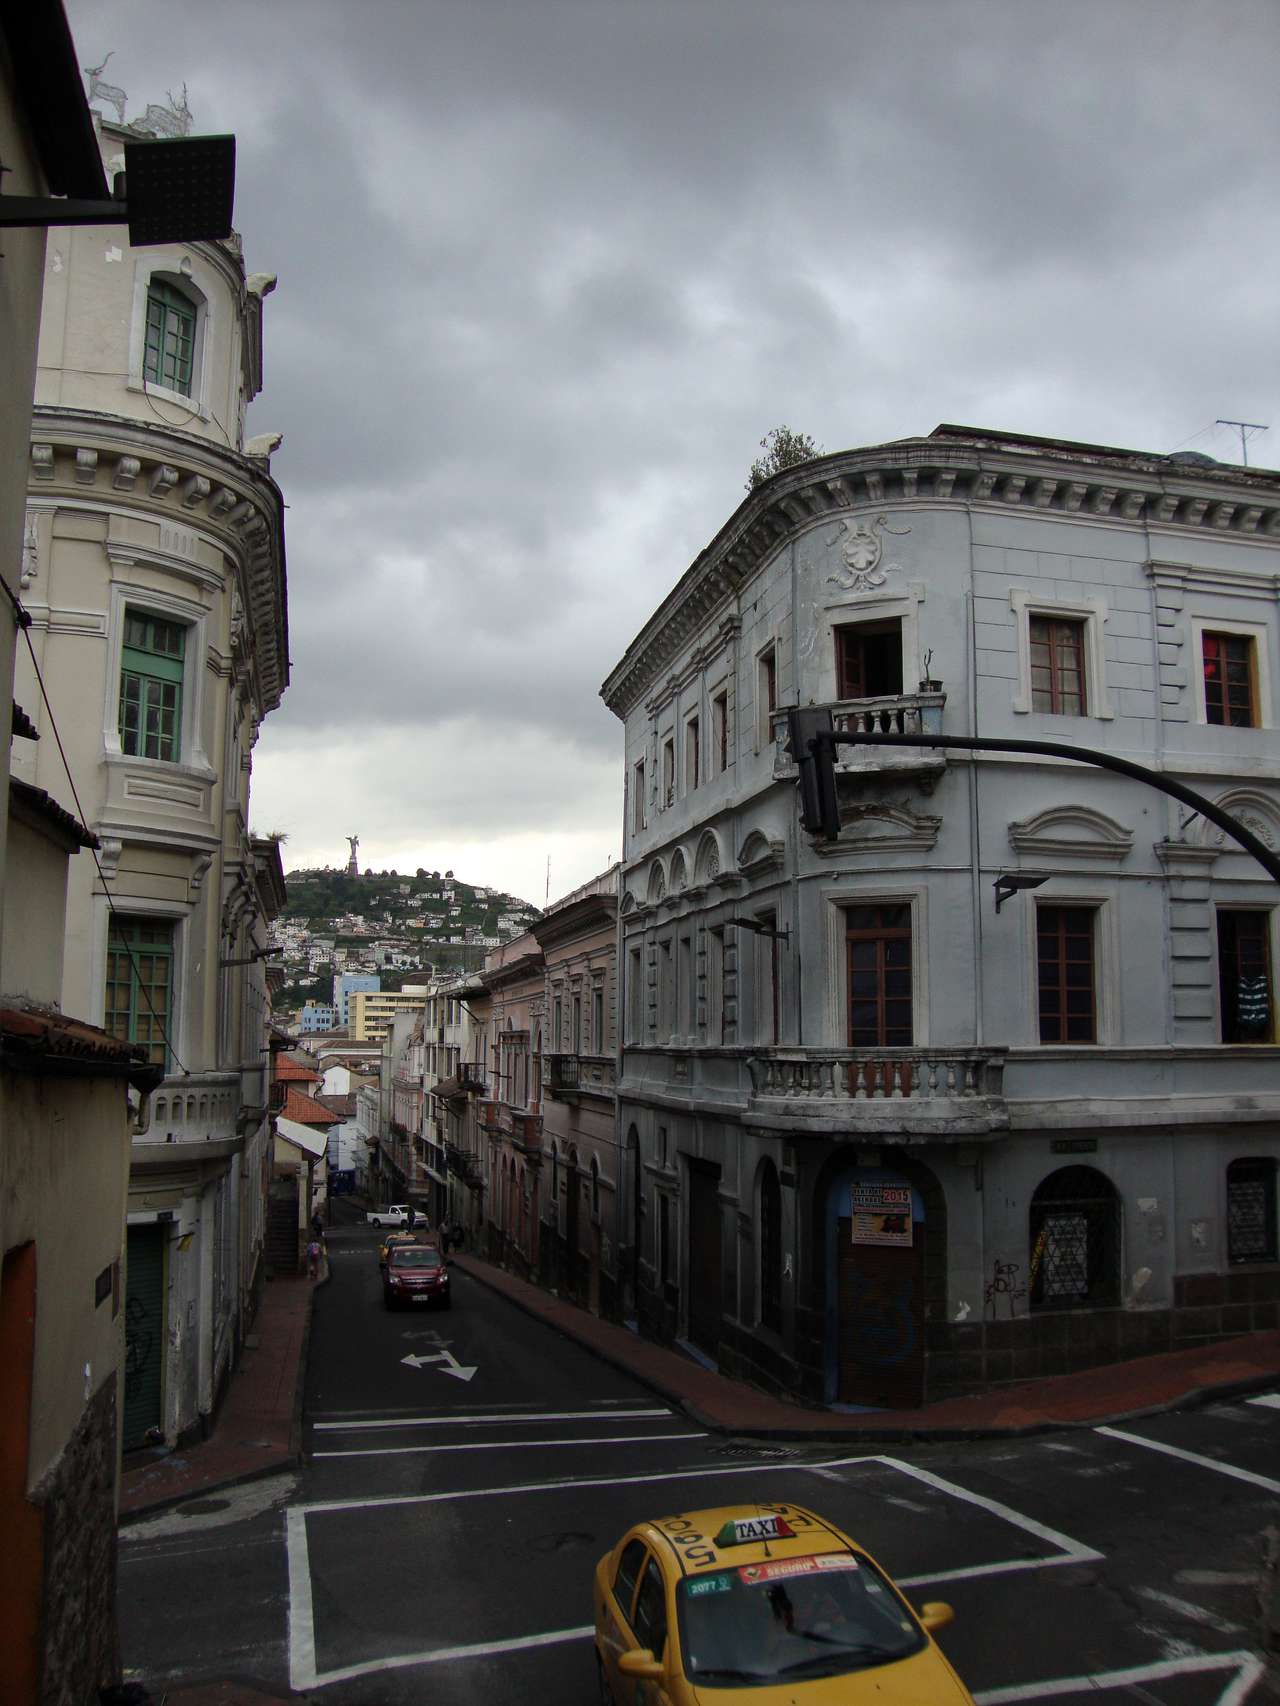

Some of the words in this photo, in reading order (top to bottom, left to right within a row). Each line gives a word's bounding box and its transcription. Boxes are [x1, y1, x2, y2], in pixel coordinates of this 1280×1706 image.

[884, 1190, 909, 1202] 2015
[735, 1519, 778, 1538] TAXI
[691, 1580, 716, 1594] 2077
